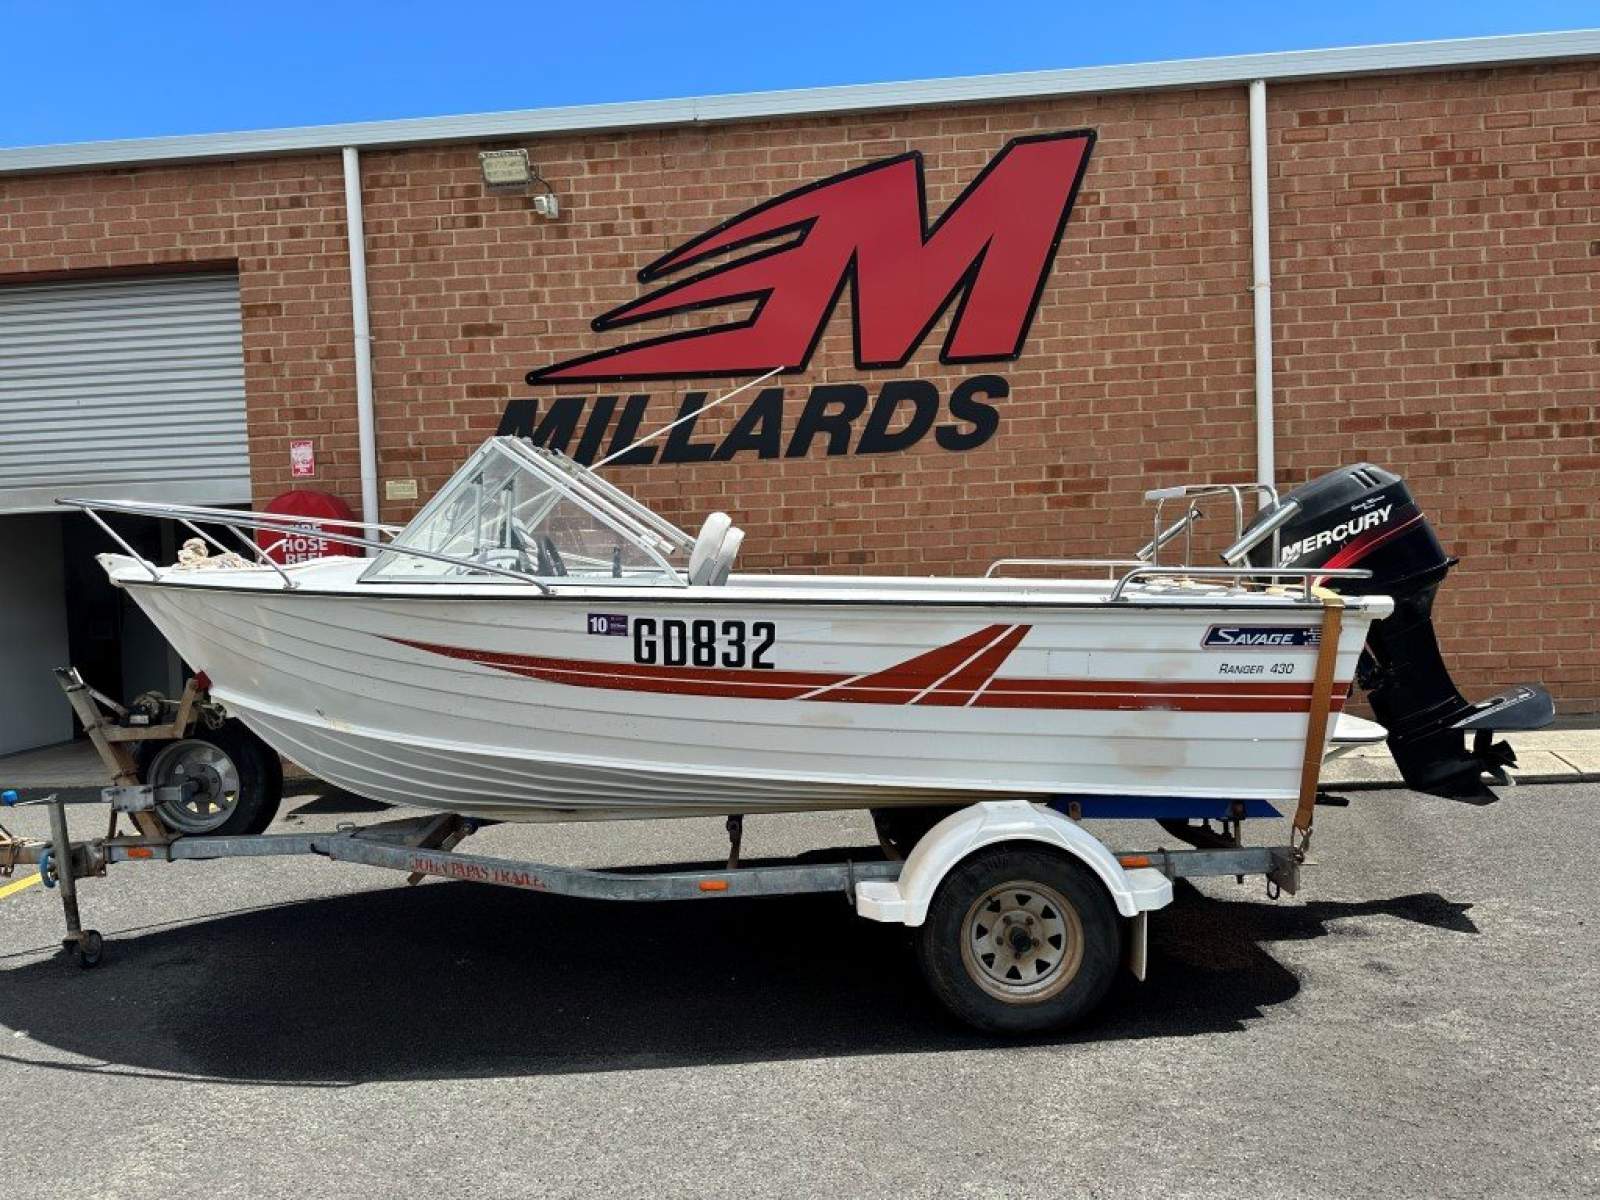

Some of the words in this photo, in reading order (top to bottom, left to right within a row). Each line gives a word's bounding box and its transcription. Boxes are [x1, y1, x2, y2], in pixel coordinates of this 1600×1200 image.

[496, 375, 1010, 466] MILLARDS
[1280, 504, 1393, 562] MERCURY
[282, 537, 329, 553] HOSE
[590, 616, 607, 632] 10
[633, 618, 776, 670] GD832
[1207, 628, 1295, 645] SAVAGE
[1218, 663, 1265, 675] RANGER
[1269, 663, 1295, 674] 430
